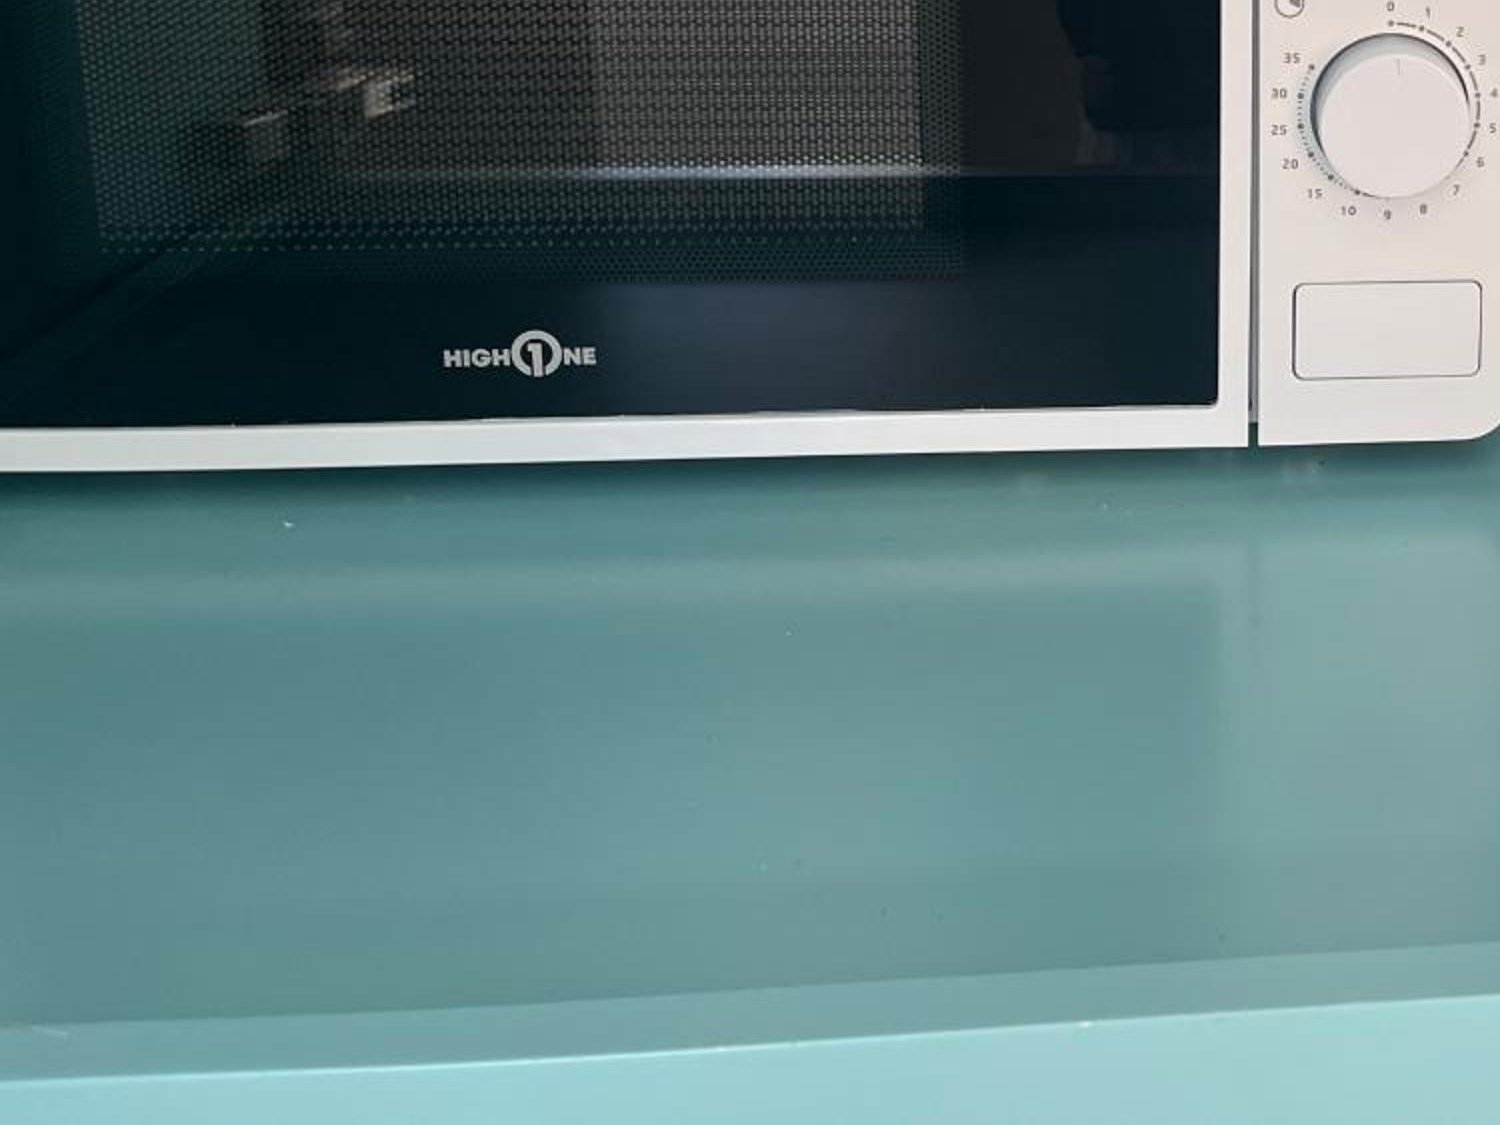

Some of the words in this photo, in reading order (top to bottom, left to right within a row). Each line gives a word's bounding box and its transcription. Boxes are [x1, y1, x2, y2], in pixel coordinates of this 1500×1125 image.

[1425, 7, 1431, 17] 1
[1456, 27, 1464, 37] 2
[1283, 53, 1300, 64] 35
[1478, 54, 1486, 65] 3
[1271, 88, 1287, 98] 30
[1490, 88, 1498, 98] 4
[1271, 125, 1287, 135] 25
[1489, 122, 1497, 133] 5
[1282, 159, 1299, 169] 20
[1307, 189, 1322, 199] 15
[1452, 185, 1460, 195] 7
[1340, 206, 1357, 216] 10
